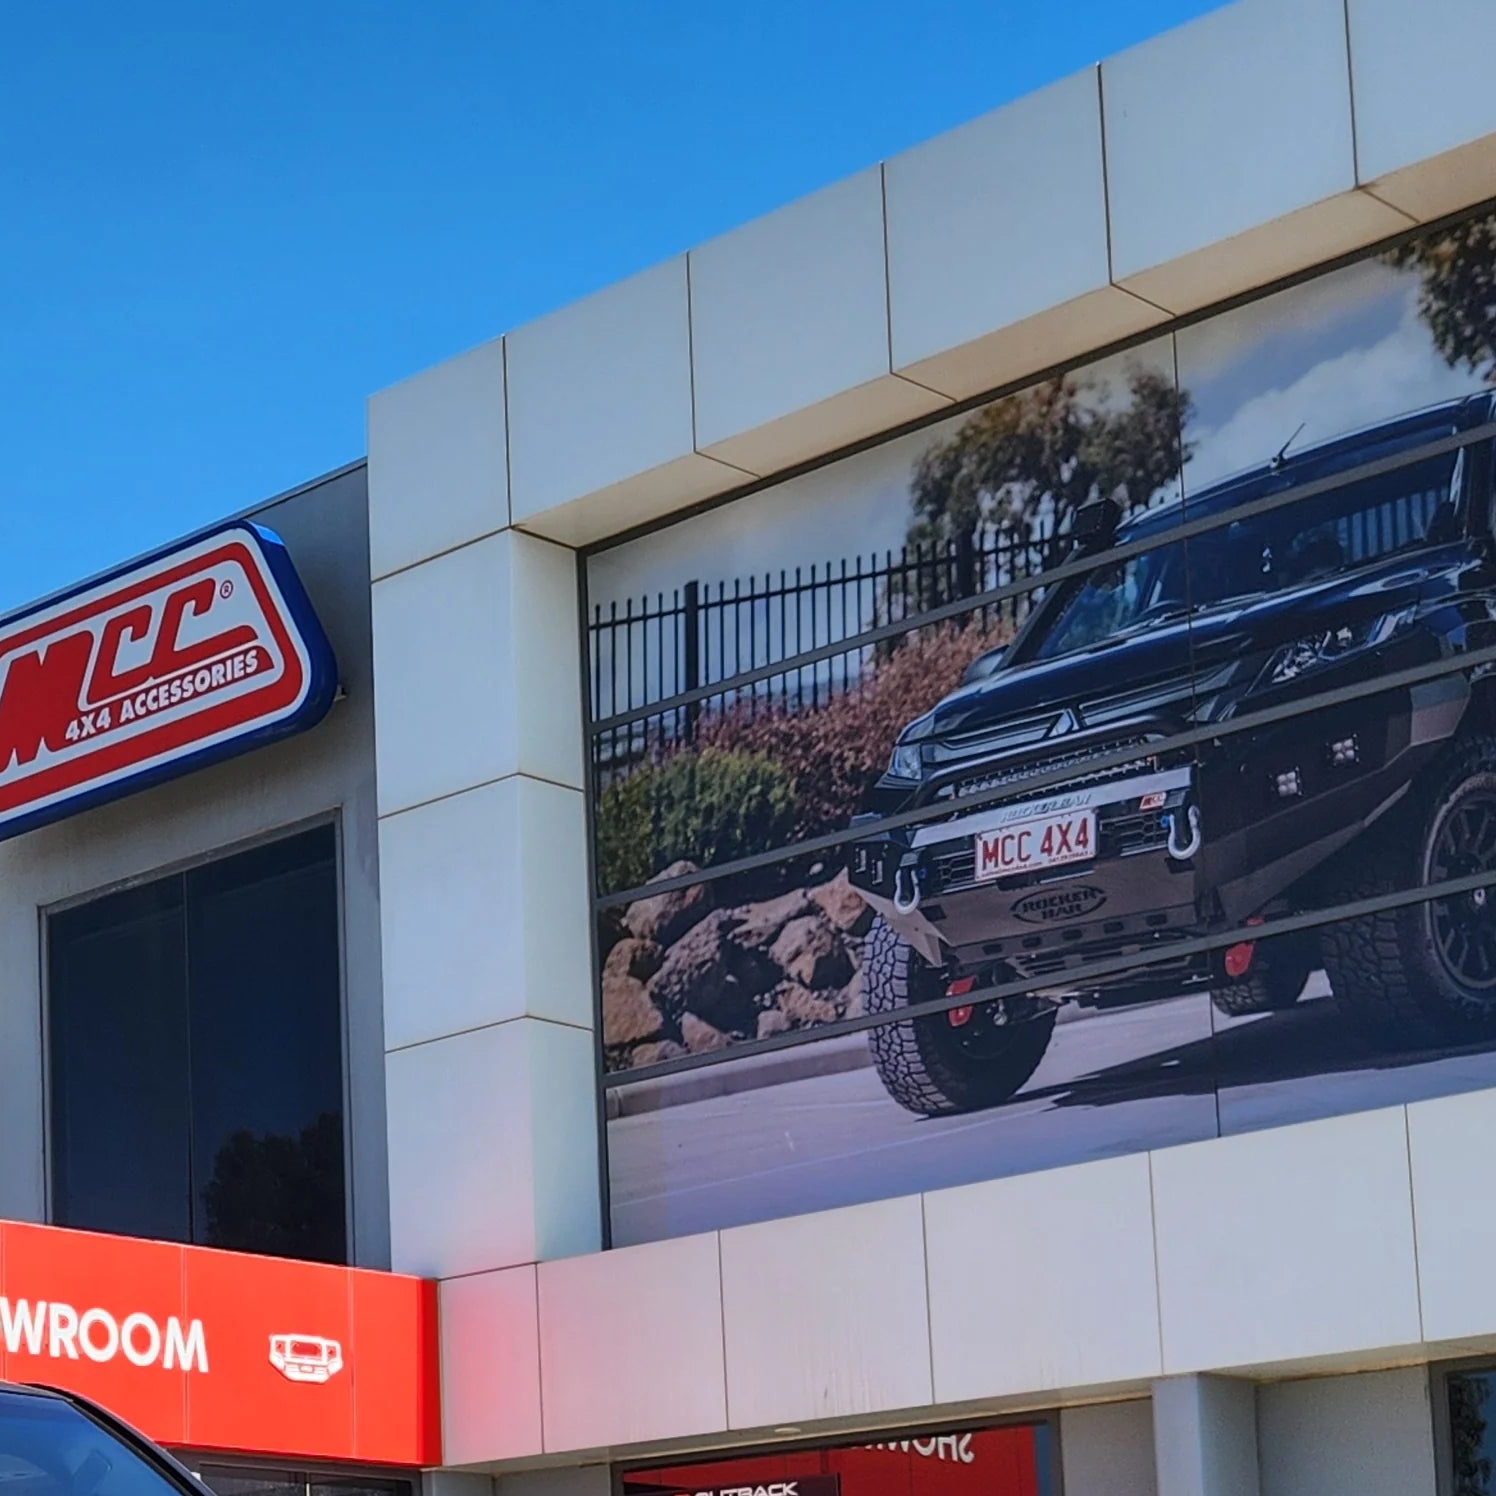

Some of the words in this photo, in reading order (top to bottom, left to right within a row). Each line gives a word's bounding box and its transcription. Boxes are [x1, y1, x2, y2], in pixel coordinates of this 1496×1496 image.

[64, 713, 111, 743] 4X4
[119, 651, 260, 722] ACCESSORIES
[981, 831, 1032, 870] MCC
[1040, 817, 1089, 857] 4X4
